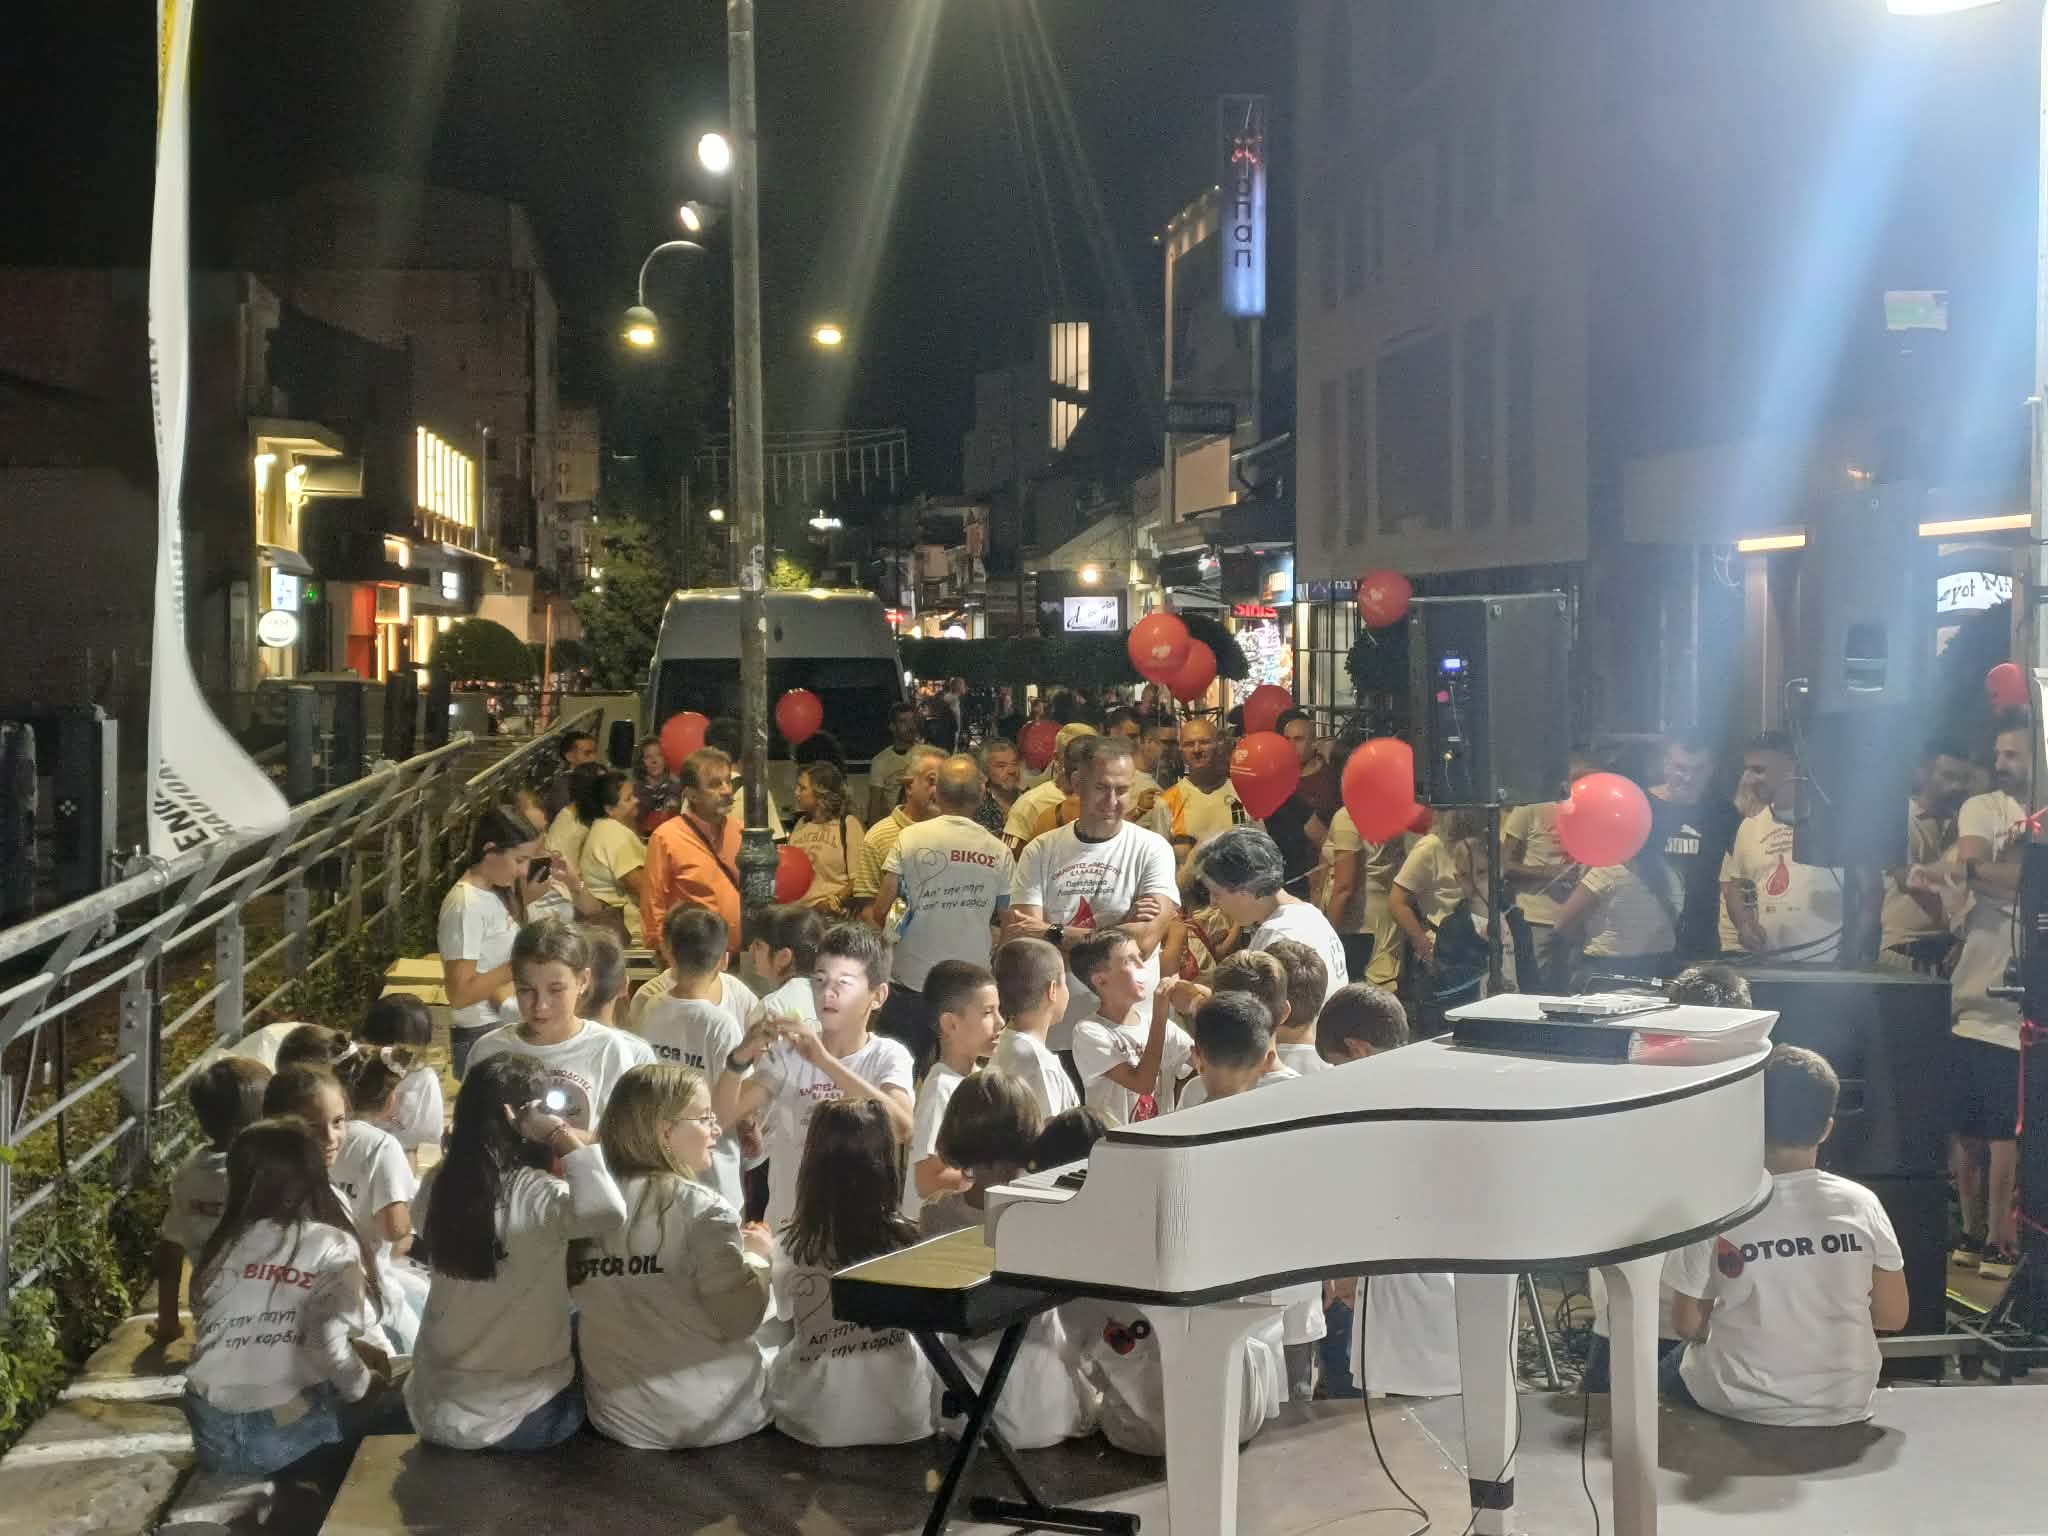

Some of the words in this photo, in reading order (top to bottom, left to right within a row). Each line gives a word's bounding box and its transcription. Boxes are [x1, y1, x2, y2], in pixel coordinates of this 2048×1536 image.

[950, 849, 996, 868] ΒΙΚΟΣ
[1820, 1233, 1863, 1254] OIL
[243, 1263, 317, 1289] ΒΙΚΟΣ
[628, 1255, 665, 1276] OIL
